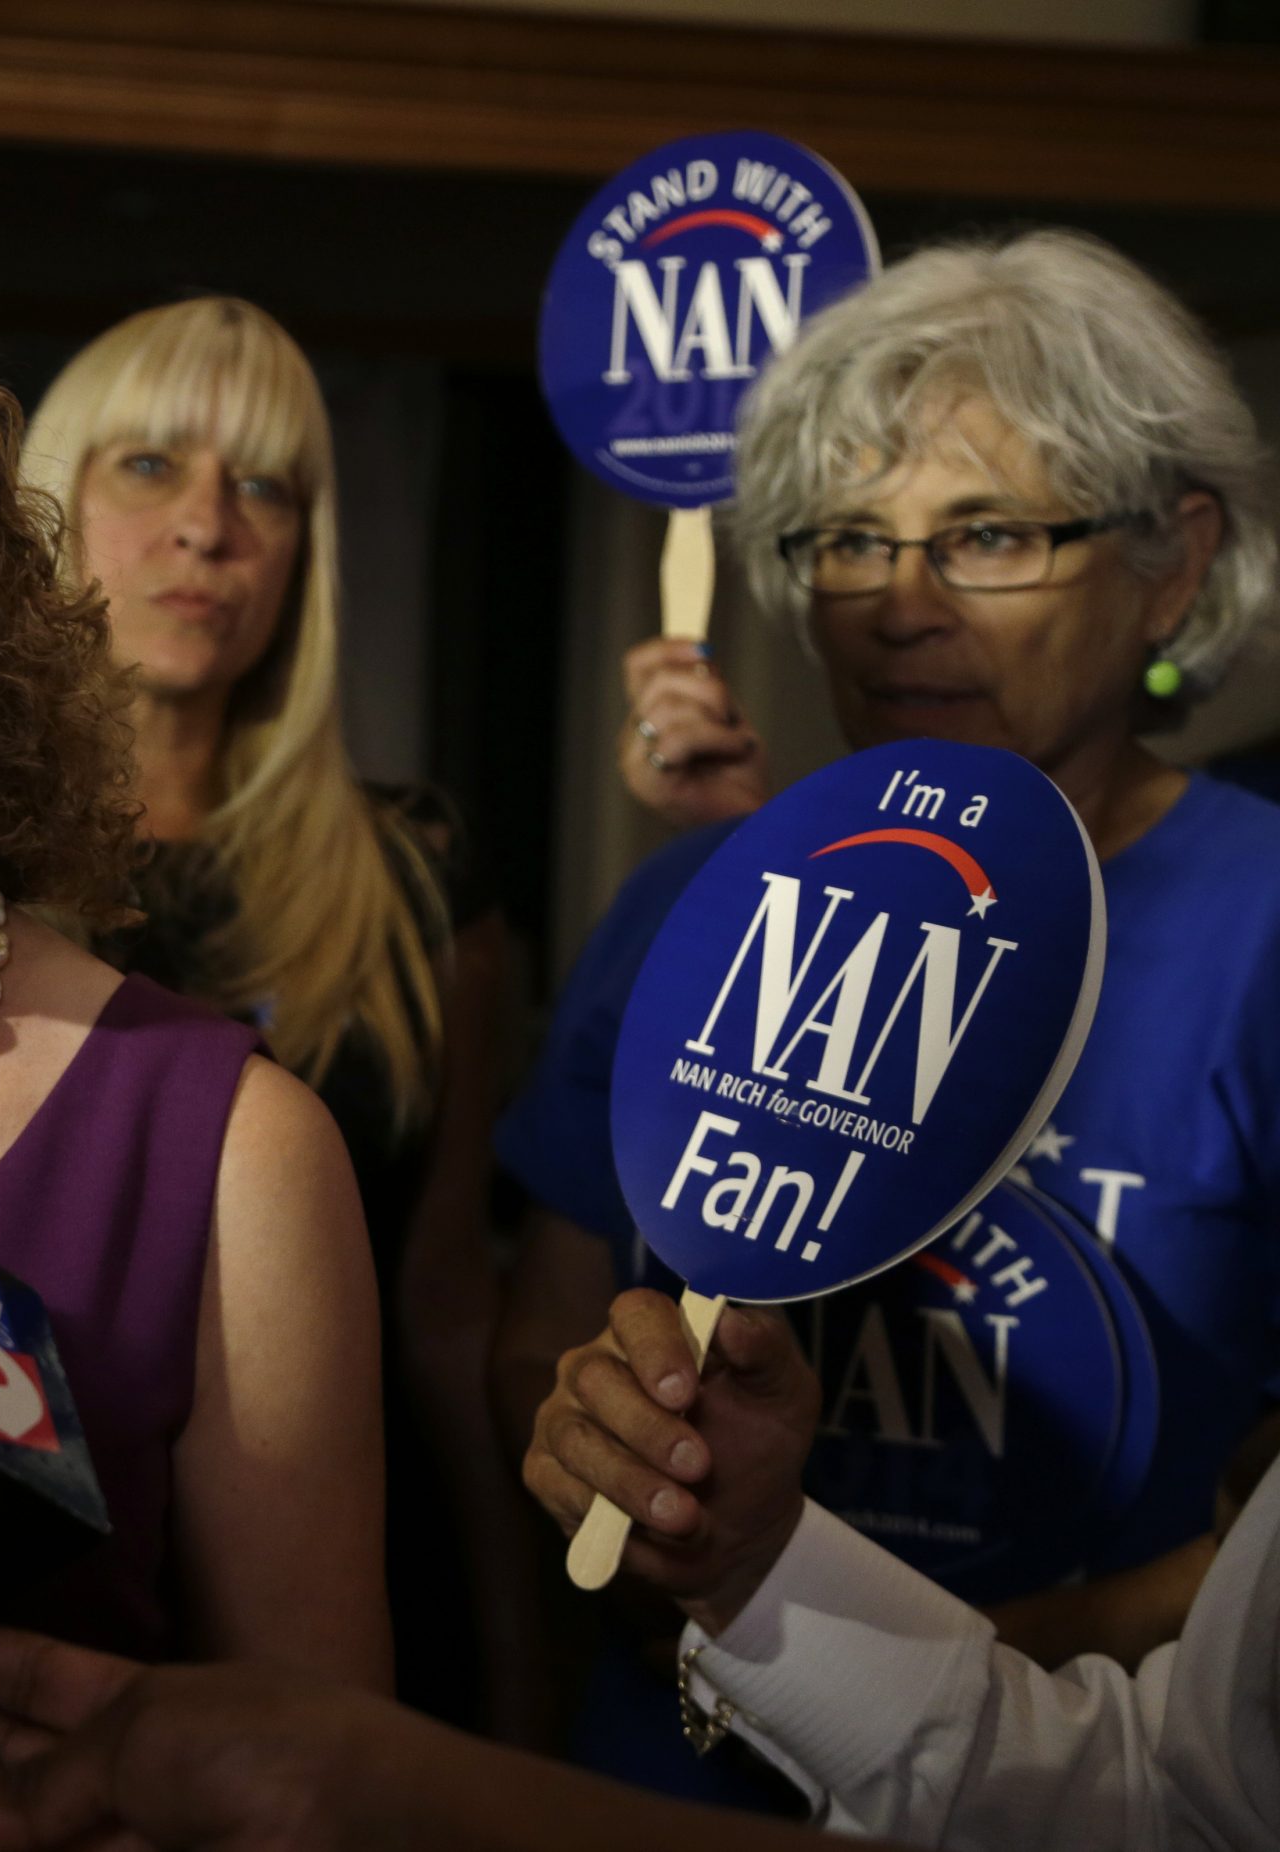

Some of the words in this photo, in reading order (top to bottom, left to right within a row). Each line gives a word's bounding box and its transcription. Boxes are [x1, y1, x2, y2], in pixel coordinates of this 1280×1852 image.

[587, 159, 719, 274] STAND
[732, 157, 832, 248] WITH
[601, 253, 811, 385] NAN
[878, 769, 946, 821] I'm
[959, 793, 989, 828] a
[684, 871, 1019, 1126] NAN
[670, 1058, 717, 1092] NAN
[716, 1072, 767, 1108] RICH
[766, 1088, 799, 1117] for
[798, 1099, 916, 1155] GOVERNOR
[660, 1110, 866, 1263] Fan!
[951, 1211, 1048, 1306] ITH
